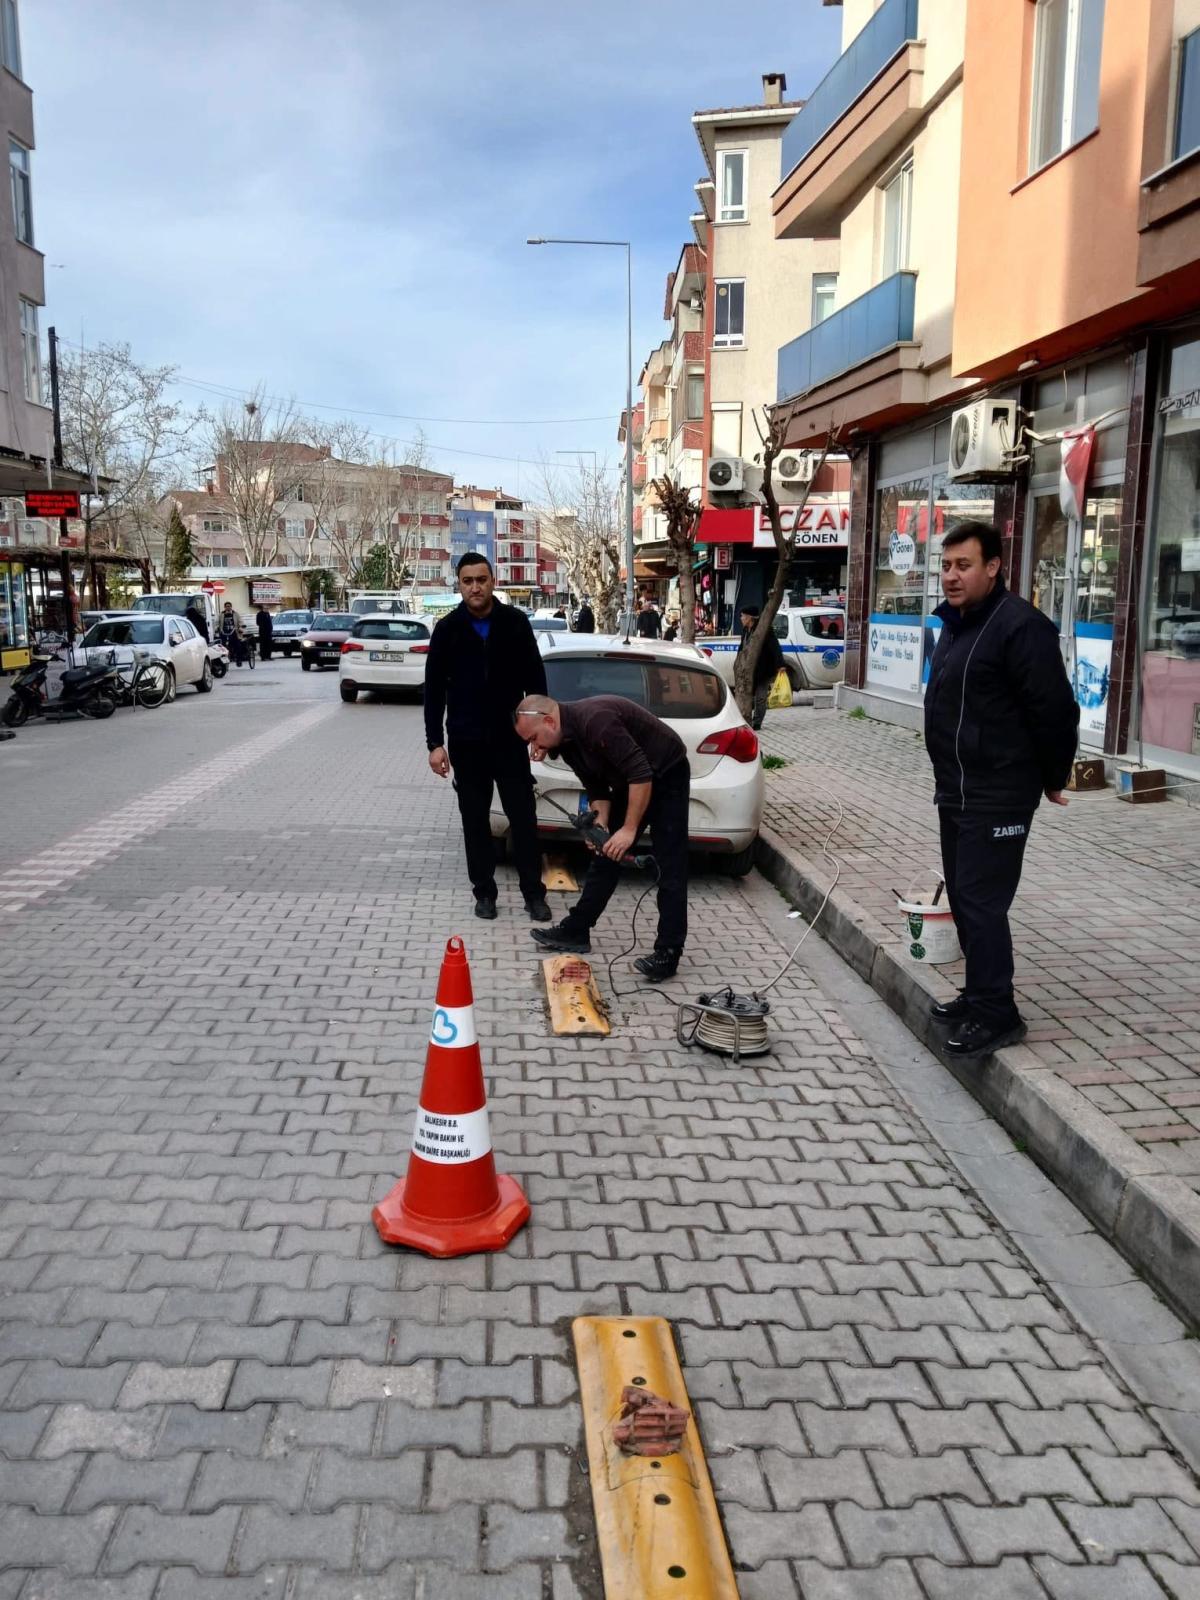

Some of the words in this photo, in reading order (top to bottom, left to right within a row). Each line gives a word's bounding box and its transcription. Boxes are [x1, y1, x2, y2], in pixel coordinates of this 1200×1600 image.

[992, 825, 1025, 837] ZABITA
[426, 1130, 439, 1140] YAPIM
[440, 1134, 456, 1142] BAKIM
[457, 1135, 464, 1143] VE
[426, 1146, 440, 1156] DAİRE
[440, 1148, 471, 1159] BAŞKANLIĞI
